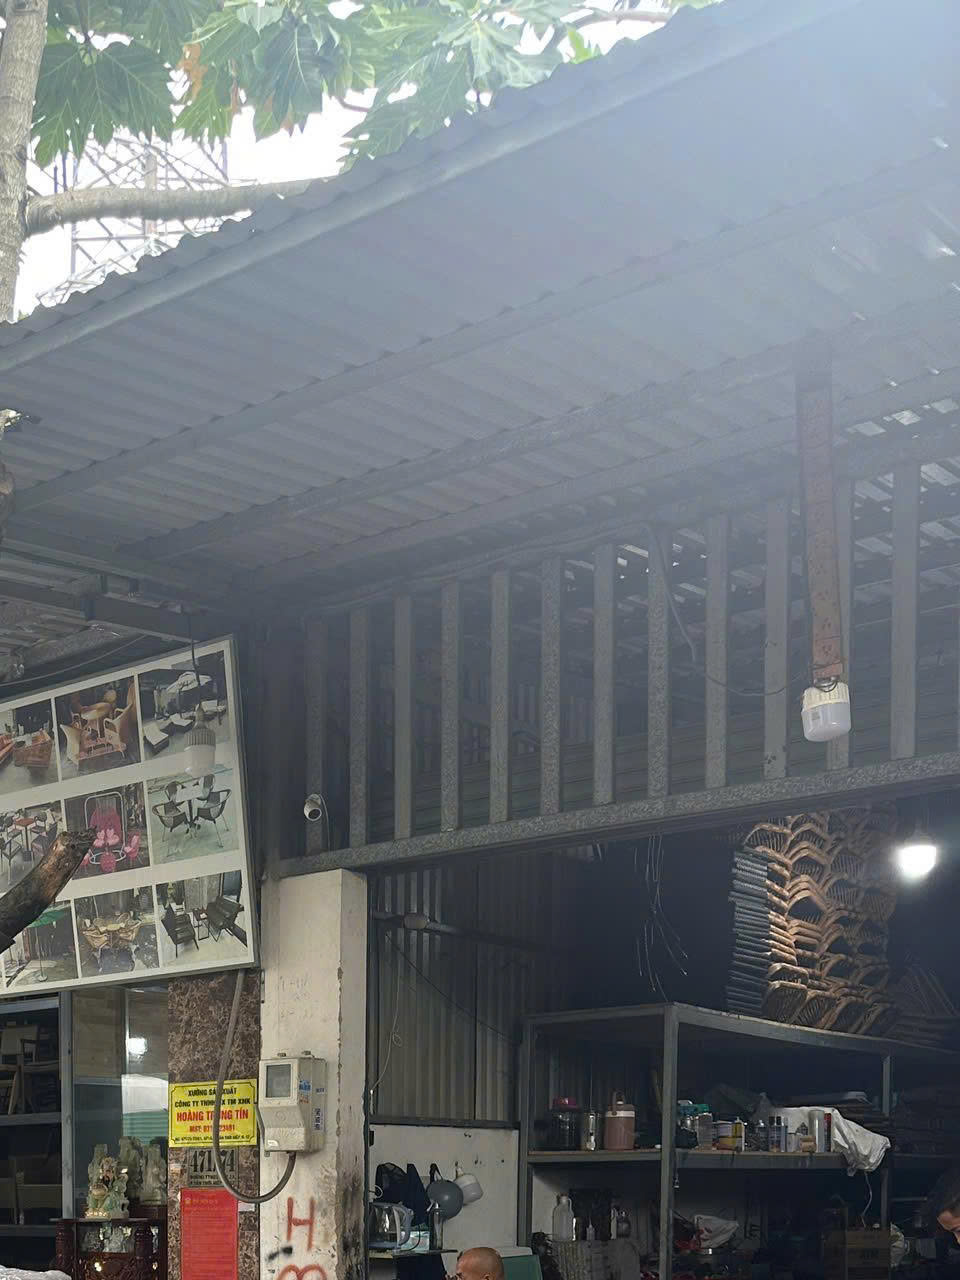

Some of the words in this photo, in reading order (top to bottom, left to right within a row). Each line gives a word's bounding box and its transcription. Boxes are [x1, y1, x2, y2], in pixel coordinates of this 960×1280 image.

[174, 1099, 191, 1108] CÔNG
[176, 1109, 204, 1122] HOÀNG
[235, 1107, 249, 1120] TÍN
